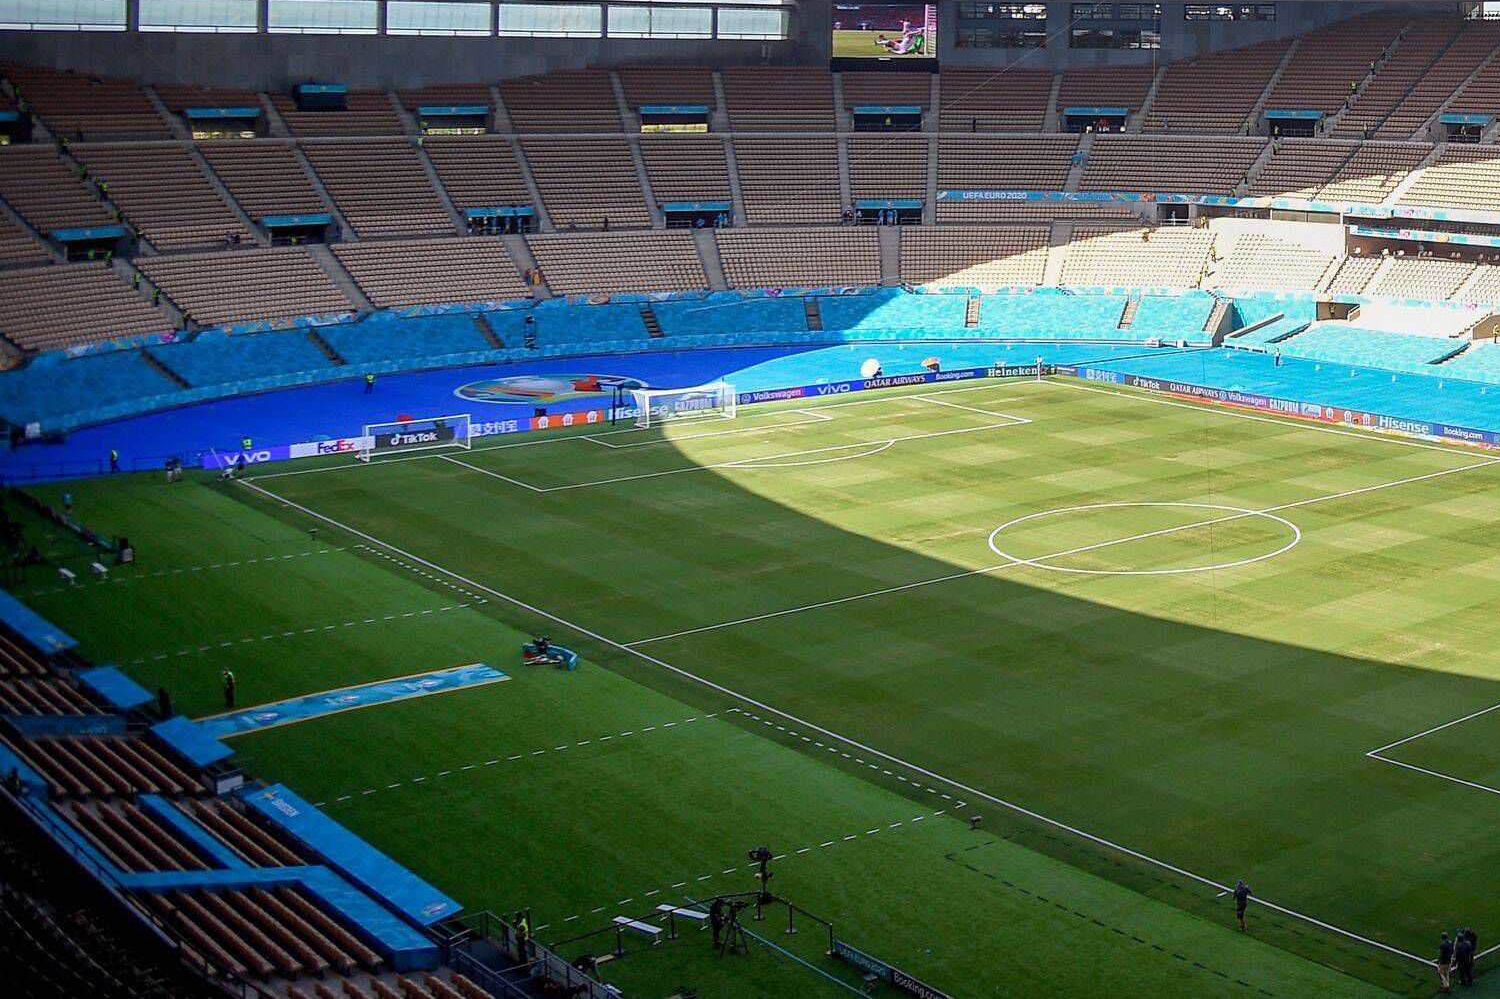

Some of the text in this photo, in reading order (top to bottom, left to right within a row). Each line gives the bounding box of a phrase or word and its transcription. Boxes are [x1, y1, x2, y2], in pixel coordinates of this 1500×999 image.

[935, 371, 974, 381] Booking.com
[987, 366, 1037, 378] Heineken
[817, 383, 850, 395] vivo
[863, 375, 926, 390] QATAR AIRWAYS
[1140, 379, 1161, 390] TikTok
[752, 388, 801, 402] Volkswagen
[1170, 382, 1219, 399] QATAR AIRWAYS
[1227, 391, 1267, 407] Volkswagen
[1269, 398, 1299, 413] GAZPROM
[1379, 415, 1430, 434] Hisense
[403, 431, 437, 445] TikTok
[1443, 426, 1483, 441] Booking.com
[316, 439, 355, 454] FedEx
[224, 450, 271, 466] vvo
